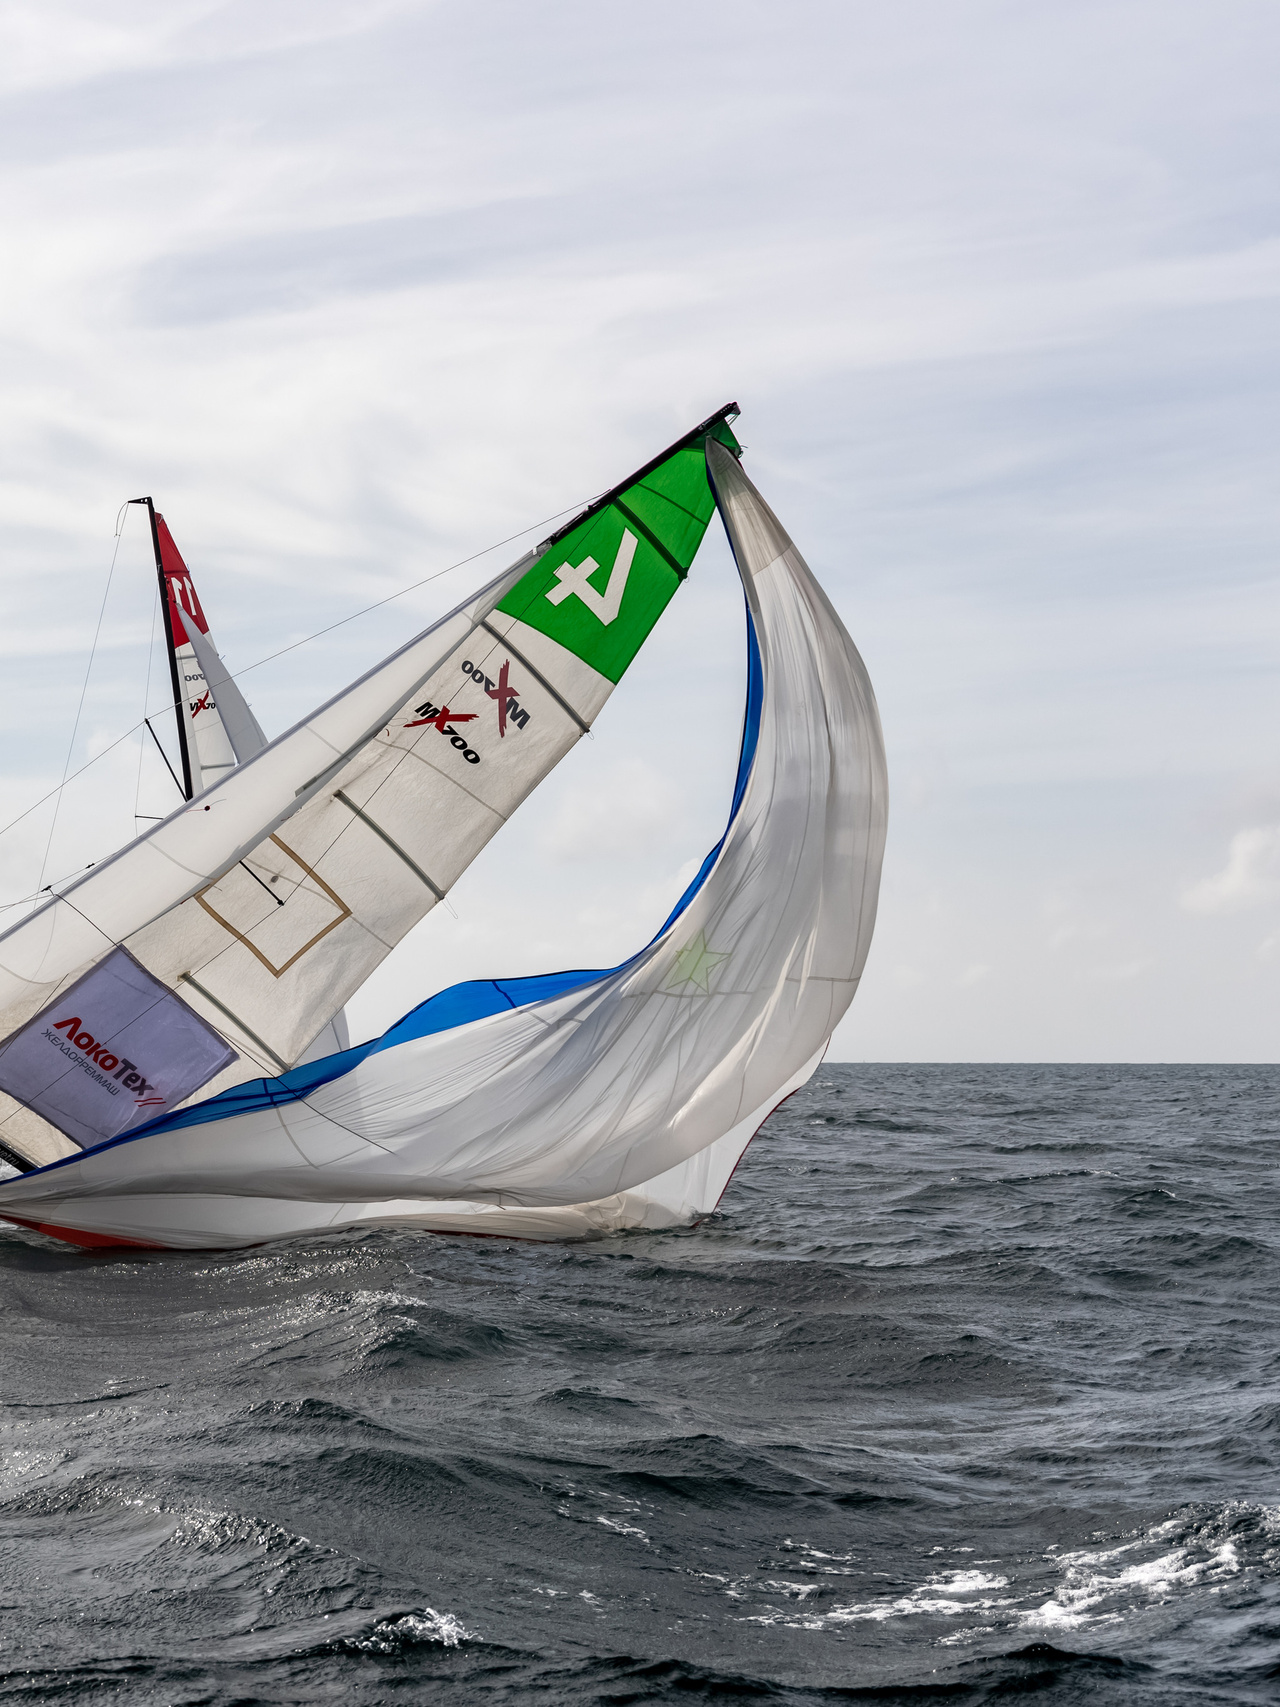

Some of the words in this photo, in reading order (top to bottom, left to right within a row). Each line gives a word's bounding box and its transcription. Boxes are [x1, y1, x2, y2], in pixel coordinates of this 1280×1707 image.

[403, 701, 481, 765] MX700
[41, 1028, 121, 1096] ЖЕЛДОРРЕММАШ
[52, 1017, 154, 1096] ЛокоТех
